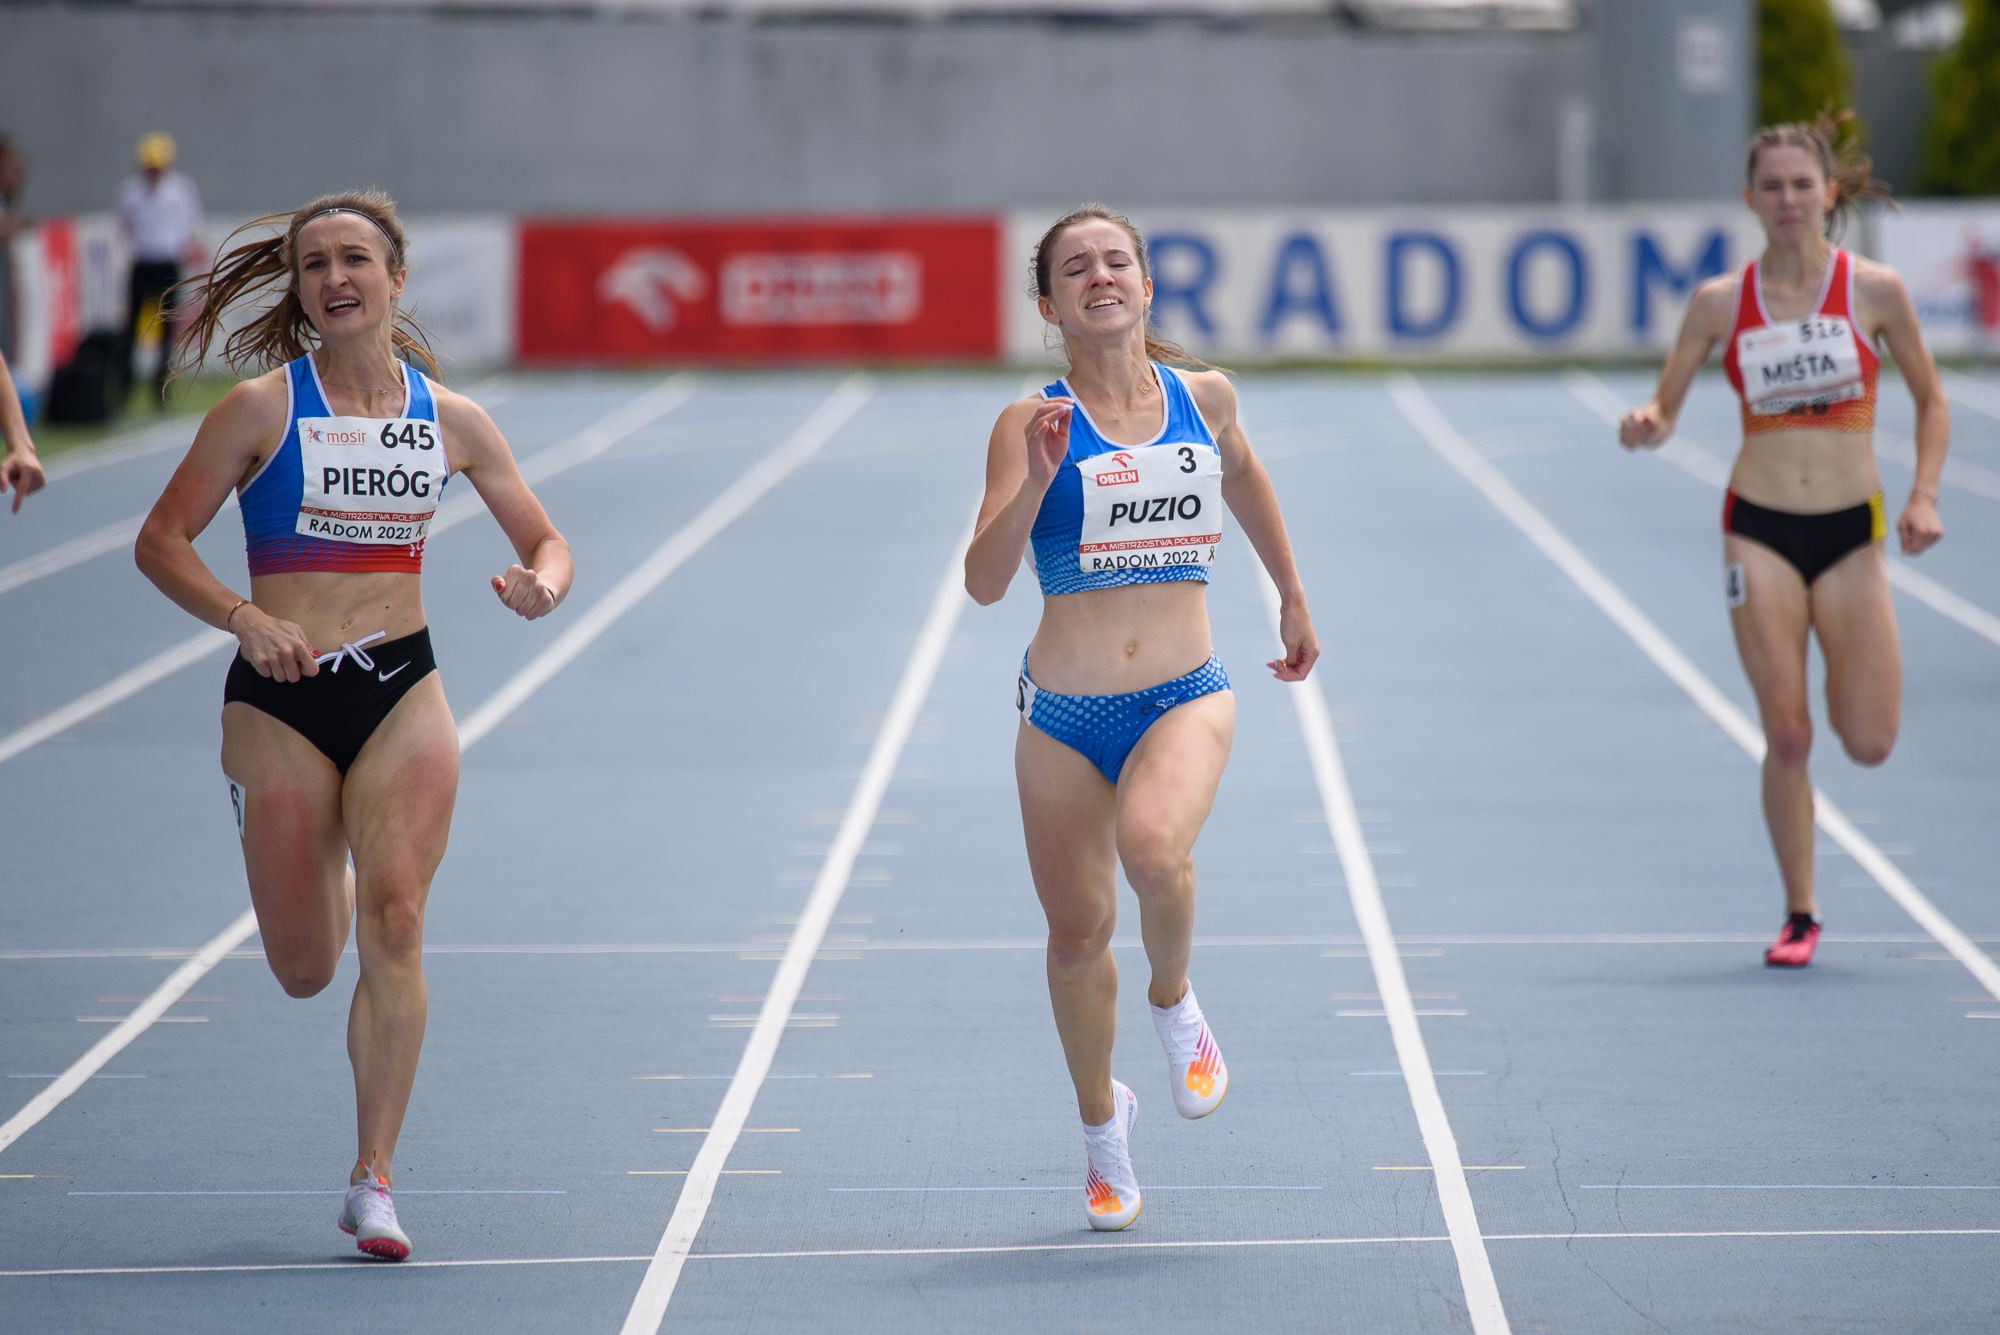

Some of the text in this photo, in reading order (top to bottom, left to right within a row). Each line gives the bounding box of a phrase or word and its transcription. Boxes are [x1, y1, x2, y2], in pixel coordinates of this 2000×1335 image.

[1146, 230, 1728, 340] RADOM
[326, 429, 367, 443] mosir
[380, 423, 435, 450] 645
[1177, 447, 1197, 473] 3
[323, 464, 430, 498] PIERÓG
[1098, 471, 1137, 485] ORLEN
[329, 511, 390, 520] MISTRZOSTWA
[1109, 494, 1201, 527] PUZIO
[309, 518, 412, 540] RADOM 2022
[1083, 545, 1108, 553] PZLA
[1109, 539, 1173, 551] MISTRZOSTWA
[1174, 536, 1204, 546] POLSKI
[1093, 550, 1200, 570] RADOM 2022
